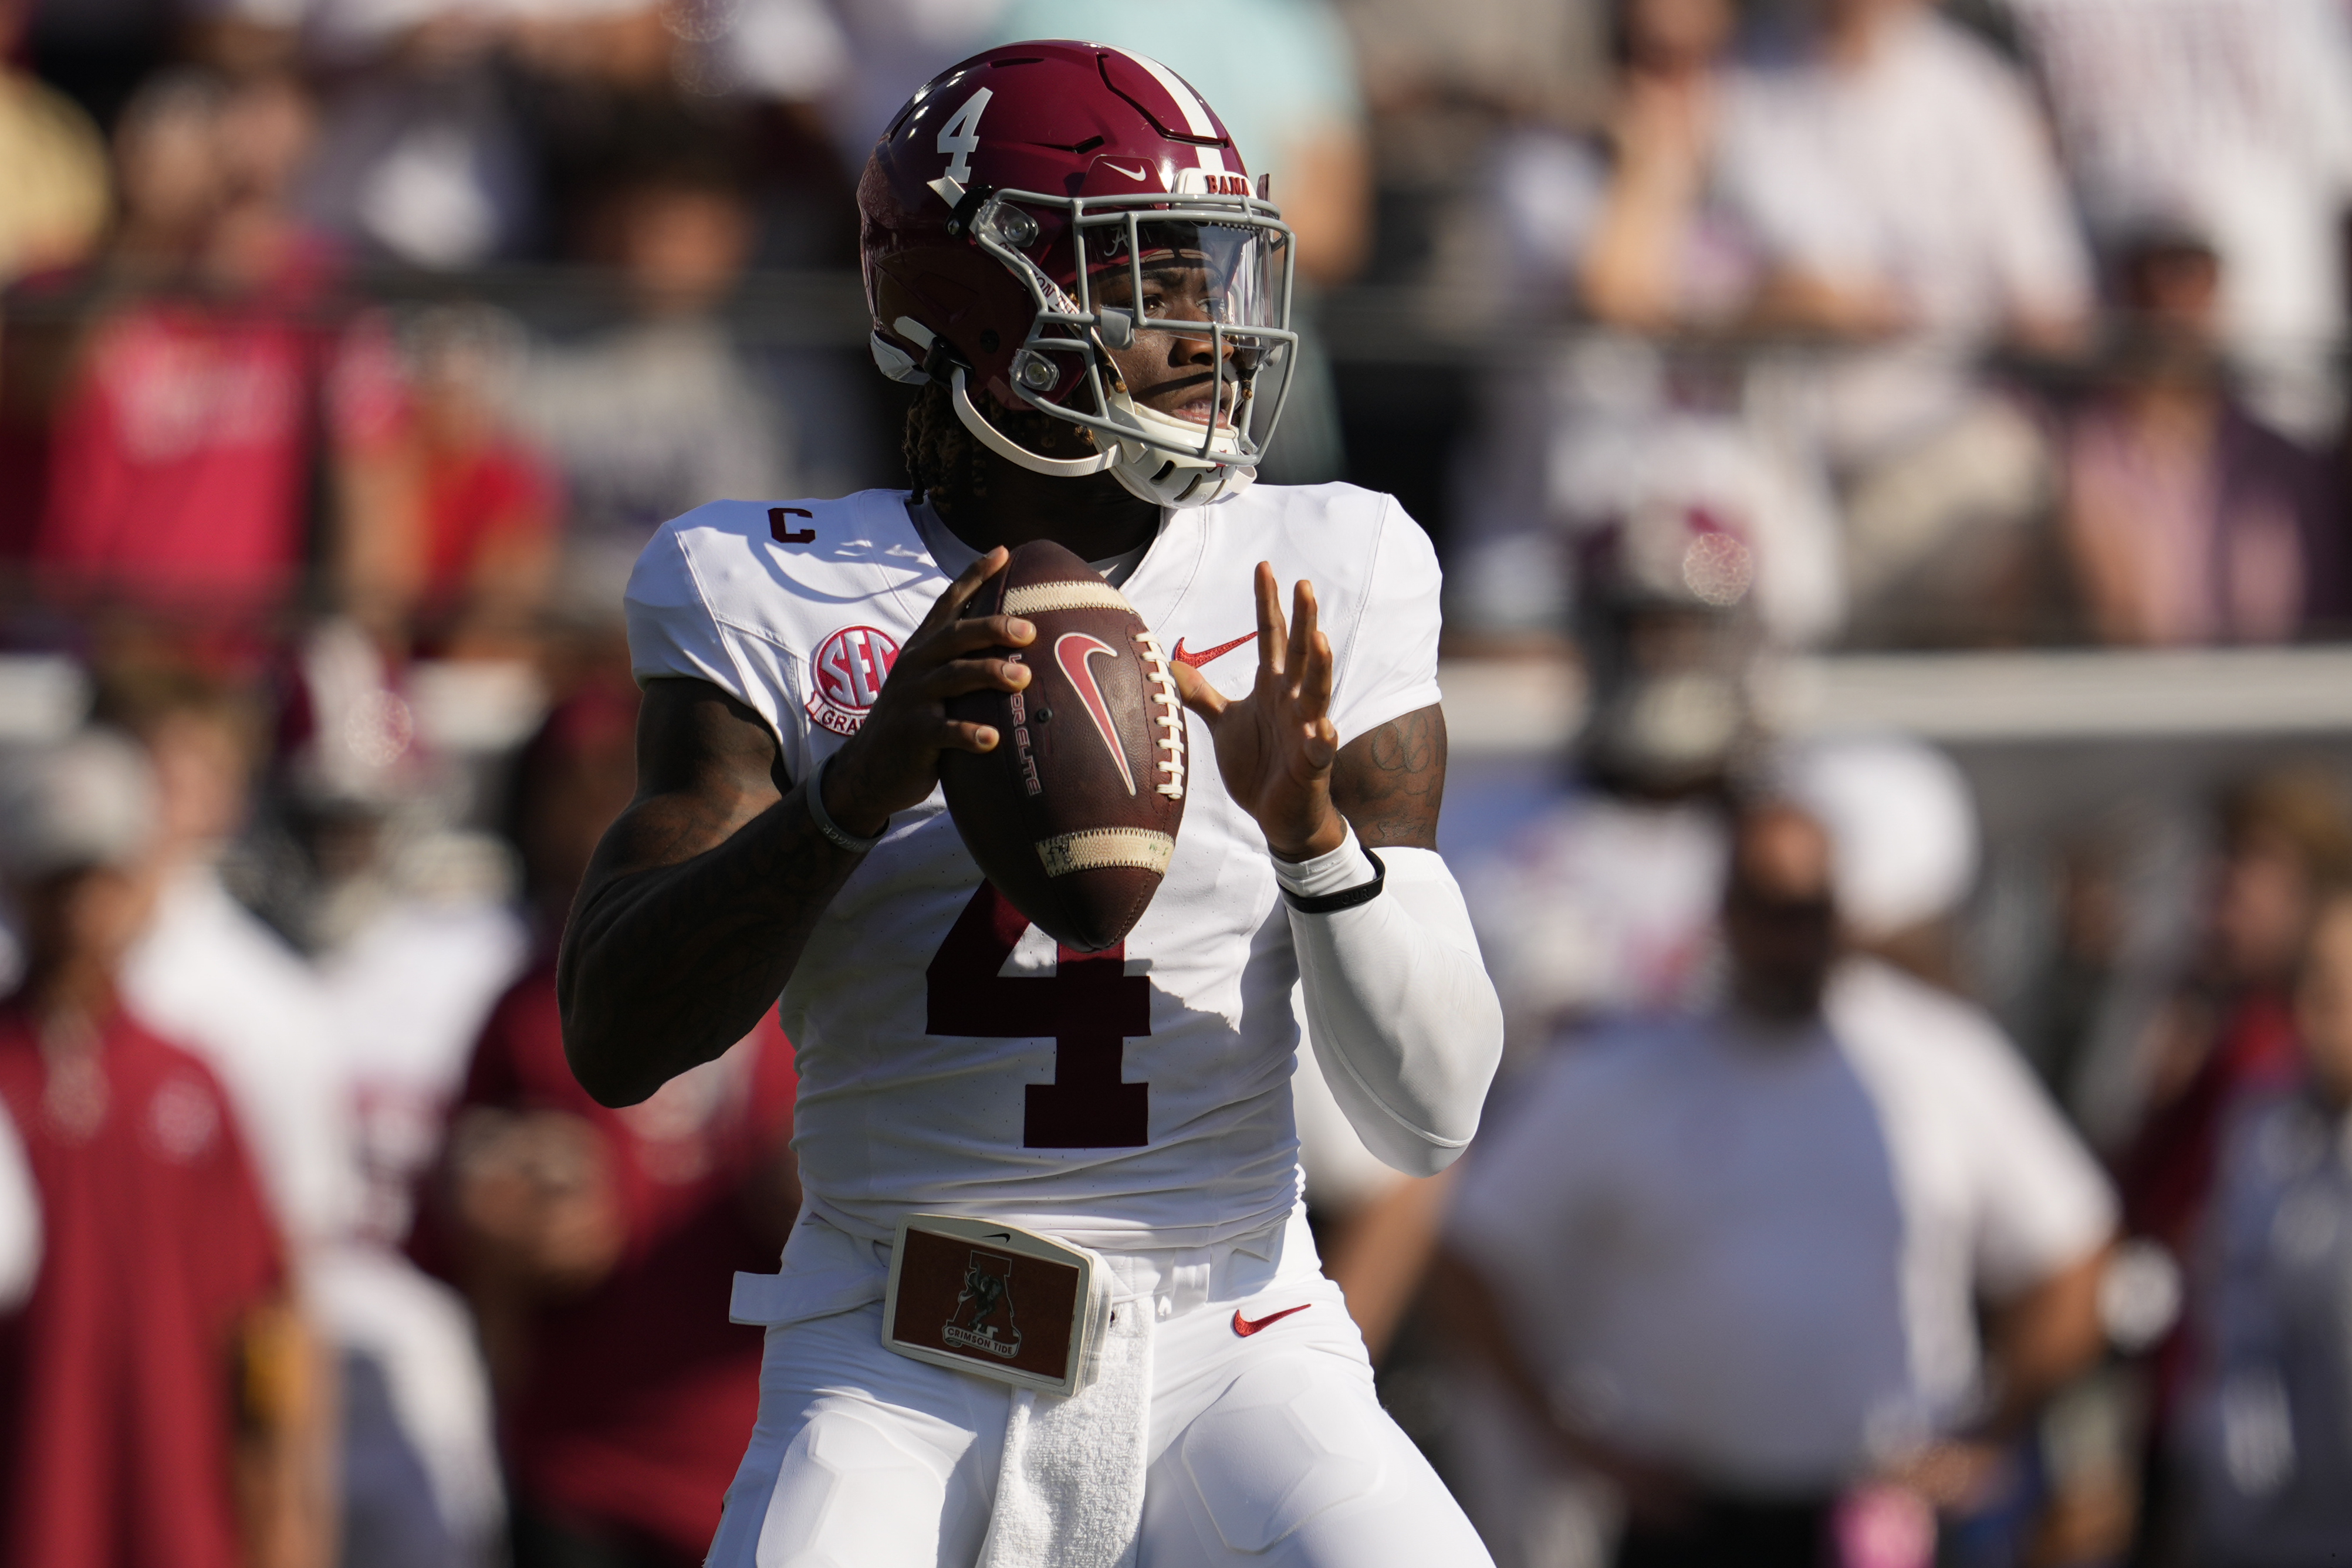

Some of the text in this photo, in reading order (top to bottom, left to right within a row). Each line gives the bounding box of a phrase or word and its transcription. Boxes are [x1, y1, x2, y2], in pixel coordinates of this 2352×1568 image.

[937, 87, 993, 184] 4
[1206, 175, 1250, 197] BAMA
[768, 508, 816, 543] C
[822, 710, 866, 733] GRA
[1015, 727, 1042, 797] ELITE
[1333, 888, 1370, 908] FOUR
[925, 877, 1151, 1148] 4
[948, 1328, 1013, 1354] CRIMSON TIDE
